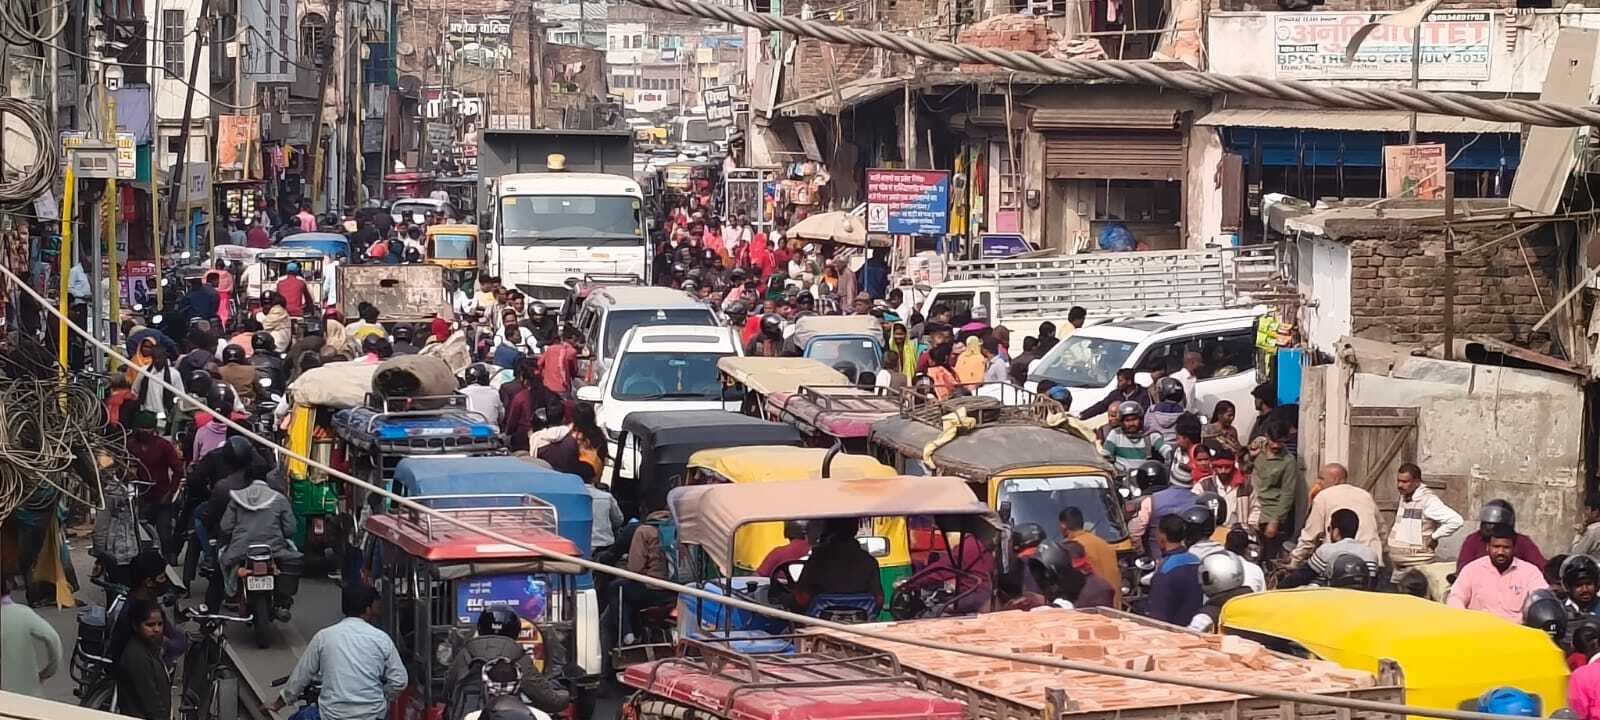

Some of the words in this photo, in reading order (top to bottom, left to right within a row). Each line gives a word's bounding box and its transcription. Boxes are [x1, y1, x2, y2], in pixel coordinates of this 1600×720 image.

[1278, 54, 1315, 64] BPSC
[1420, 53, 1452, 64] JULY
[1455, 54, 1487, 63] 2025
